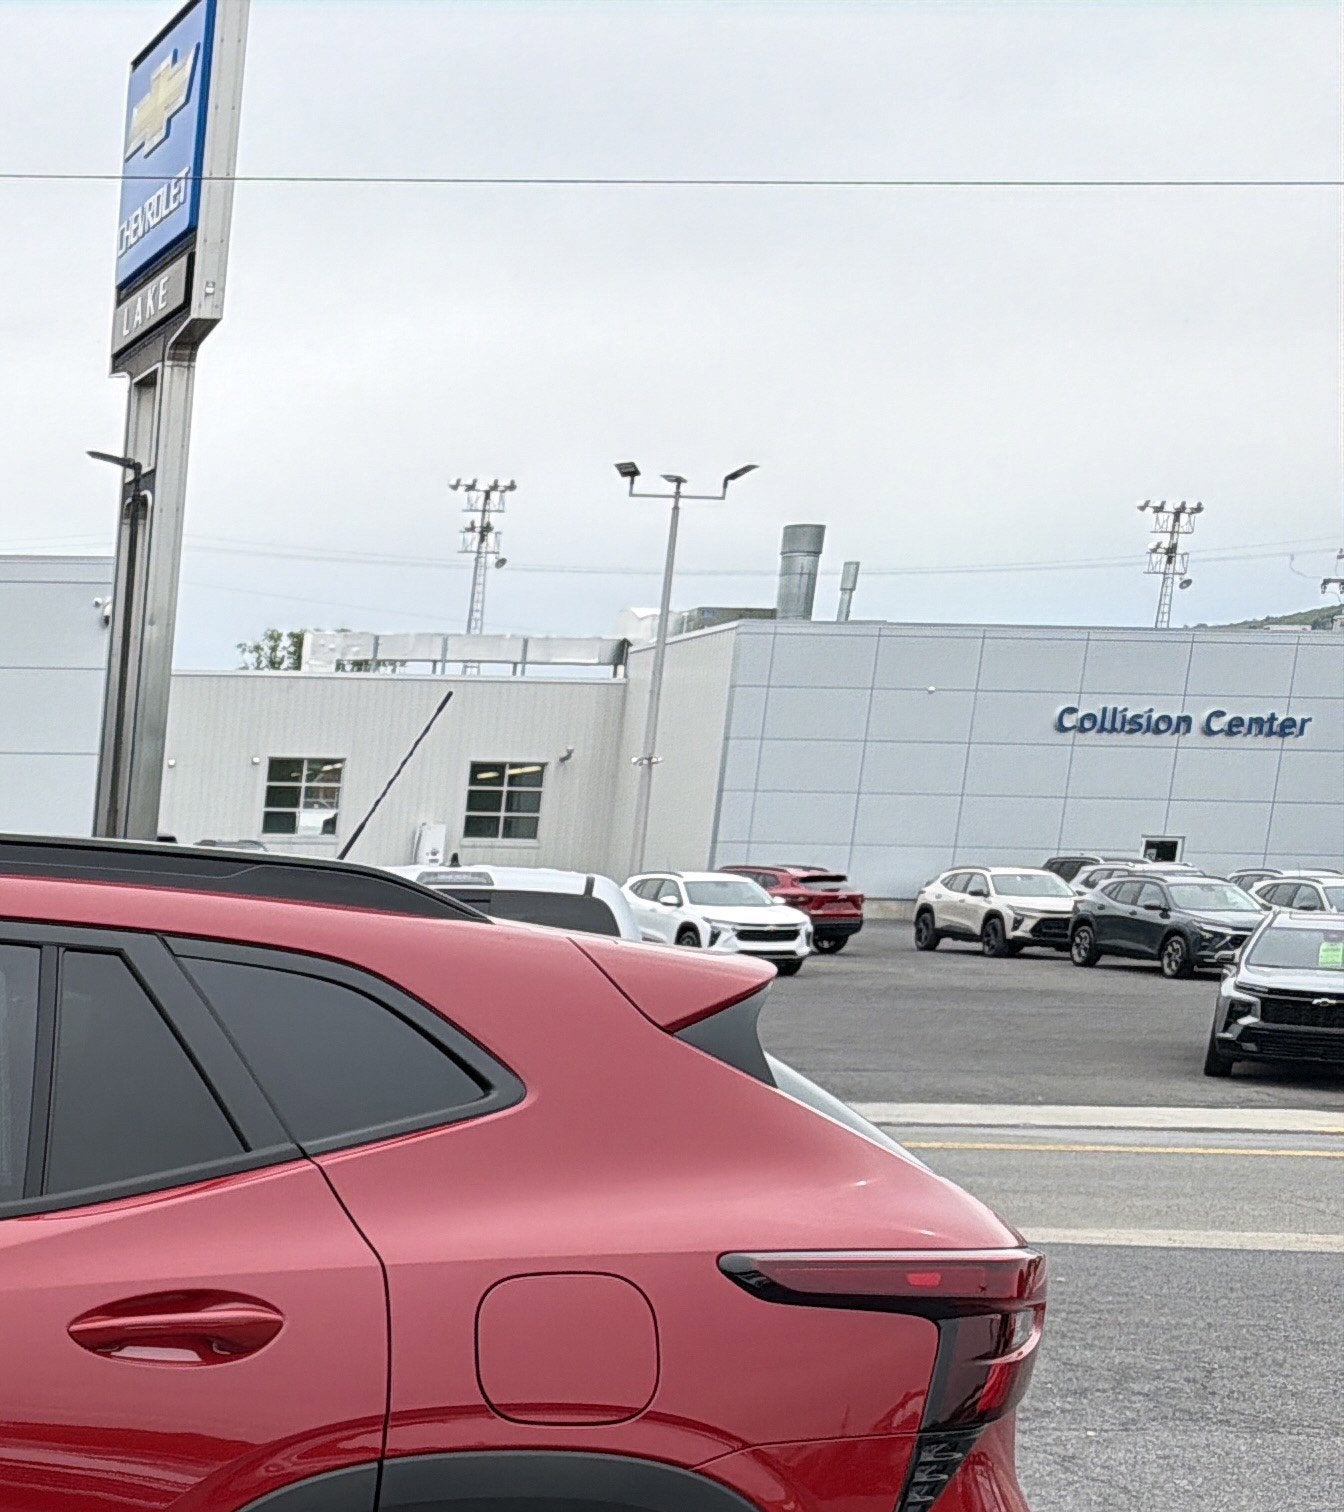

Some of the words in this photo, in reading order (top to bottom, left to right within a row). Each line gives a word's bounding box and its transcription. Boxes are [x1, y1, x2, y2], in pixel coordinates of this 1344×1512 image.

[118, 166, 191, 257] CHEVROLET
[122, 276, 169, 337] LAKE
[1055, 706, 1193, 736] Collision
[1204, 709, 1313, 739] Center
